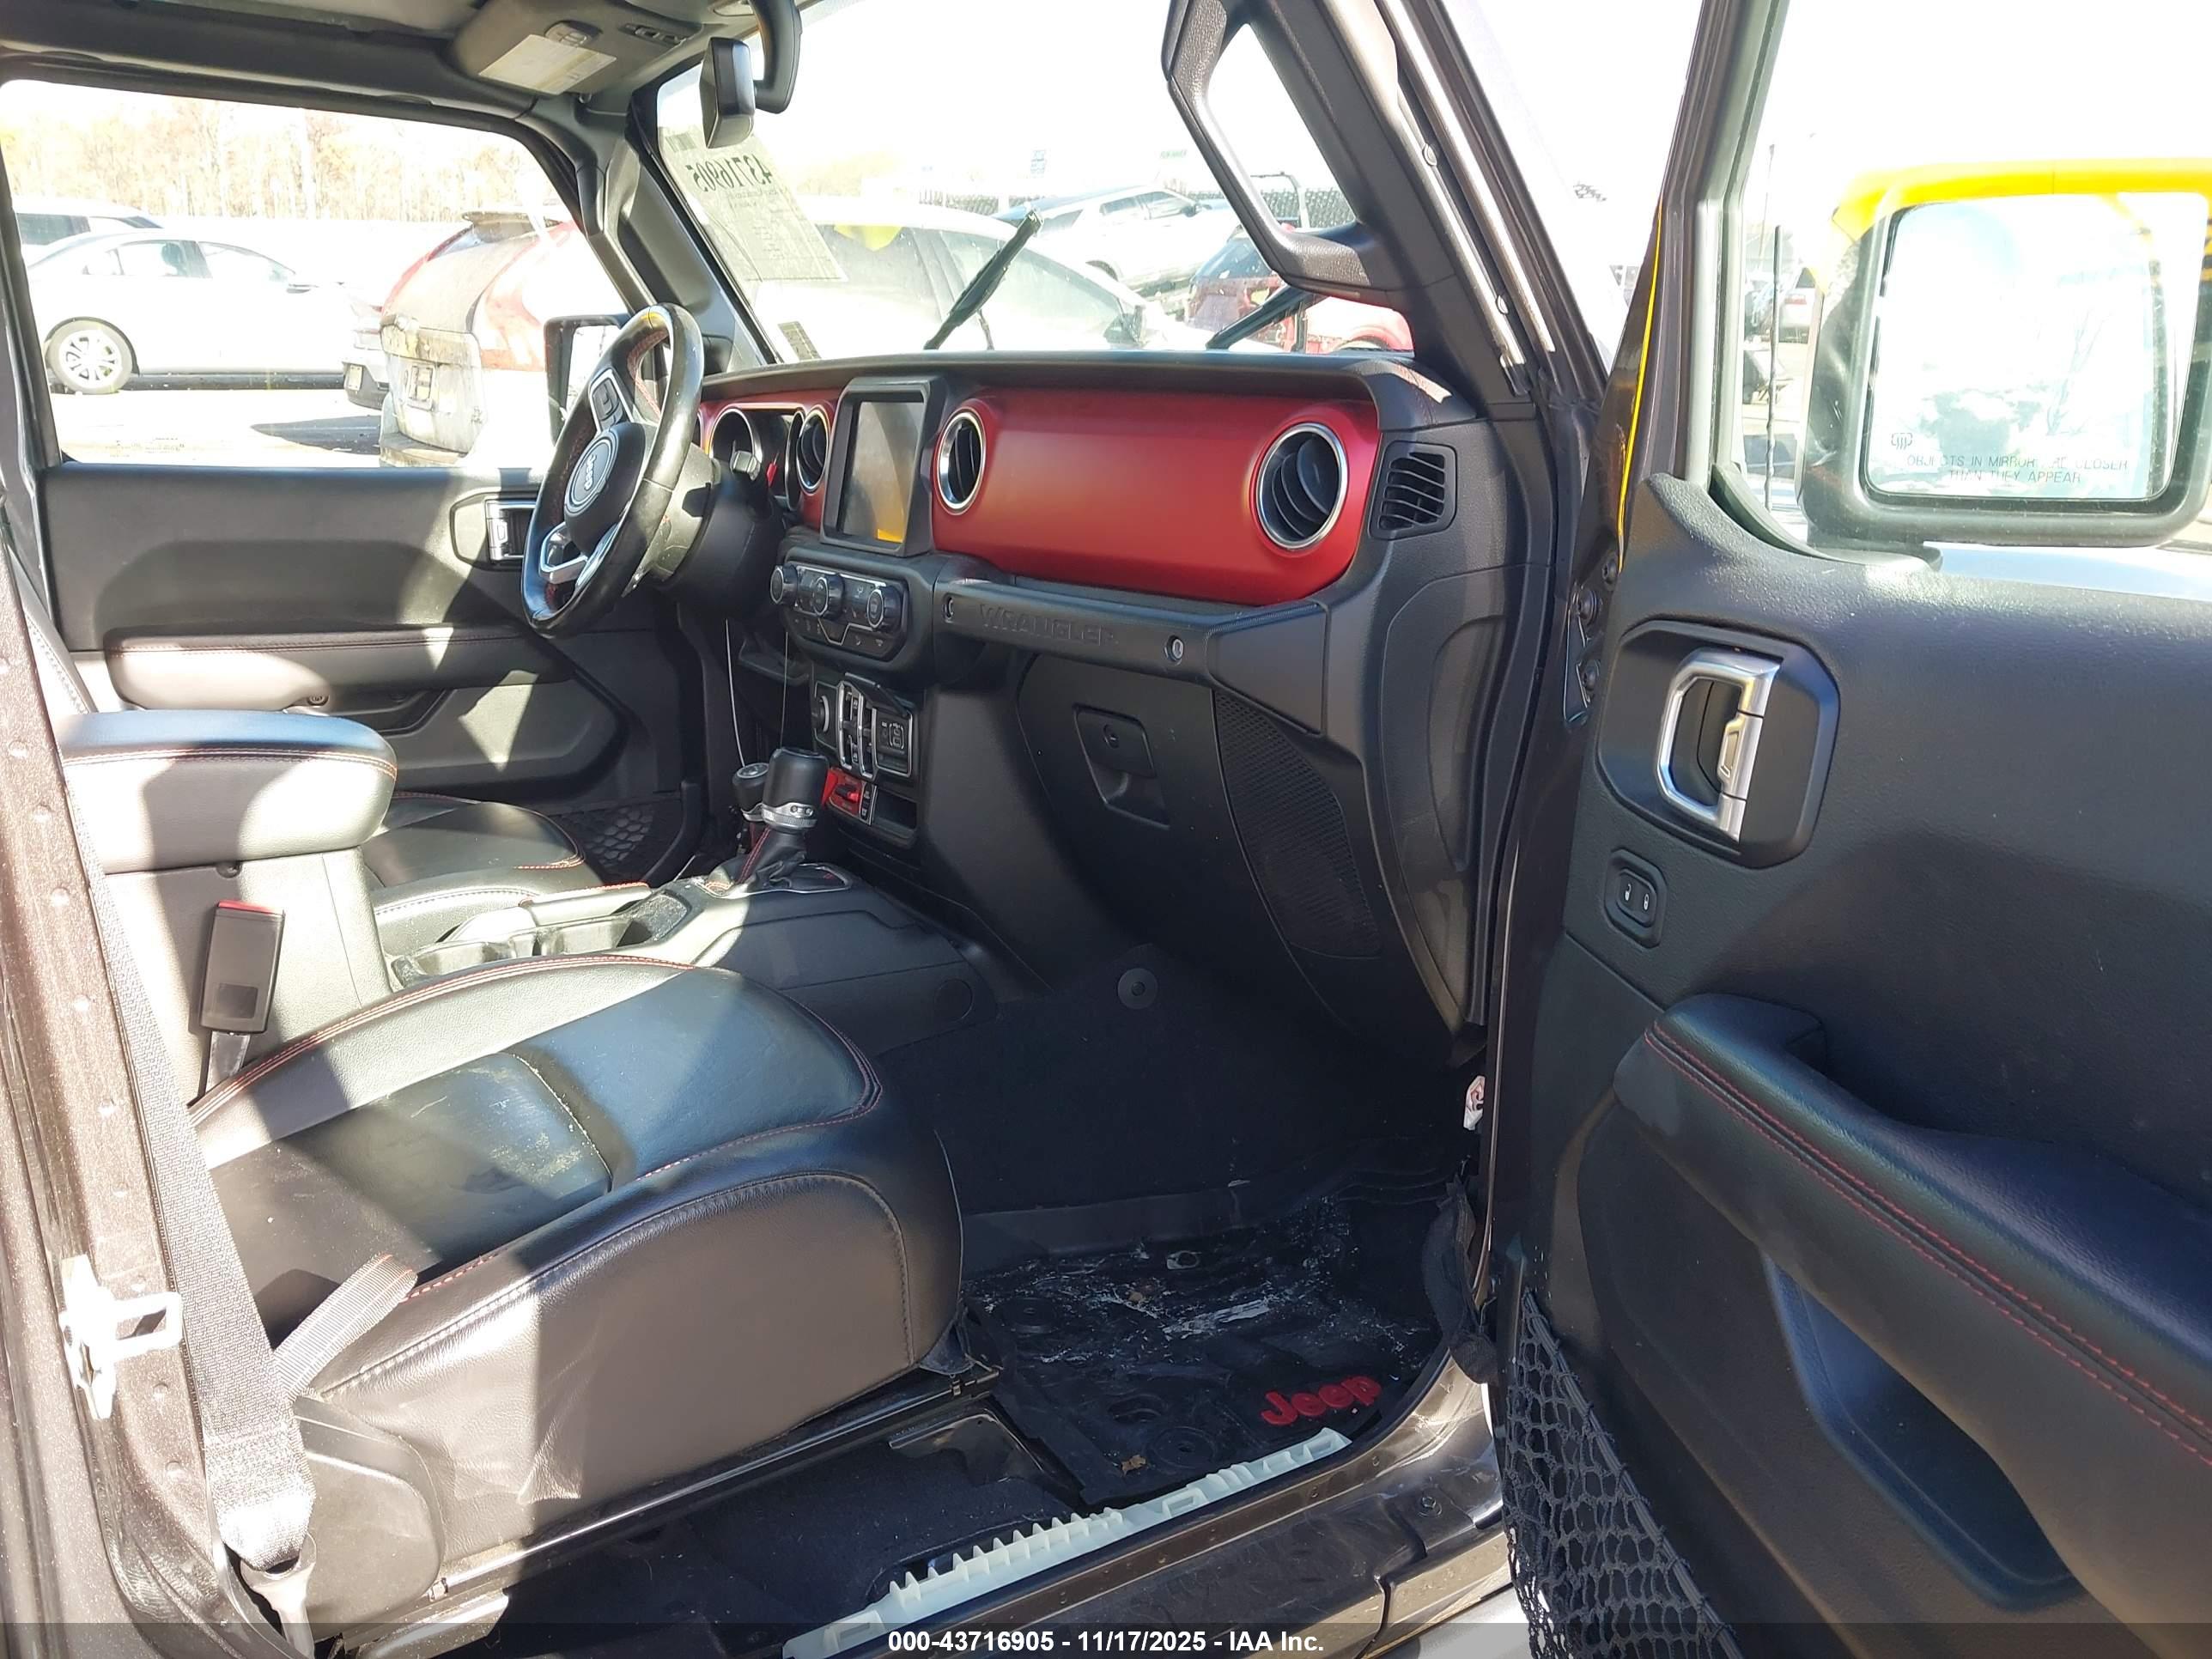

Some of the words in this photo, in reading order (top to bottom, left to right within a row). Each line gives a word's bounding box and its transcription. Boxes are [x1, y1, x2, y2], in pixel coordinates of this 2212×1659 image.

[1971, 454, 1984, 468] IN
[1988, 454, 2036, 469] MIRROR
[2027, 470, 2082, 484] APPEAR
[980, 604, 1118, 646] WRANGLER
[1261, 1376, 1382, 1425] Jeep
